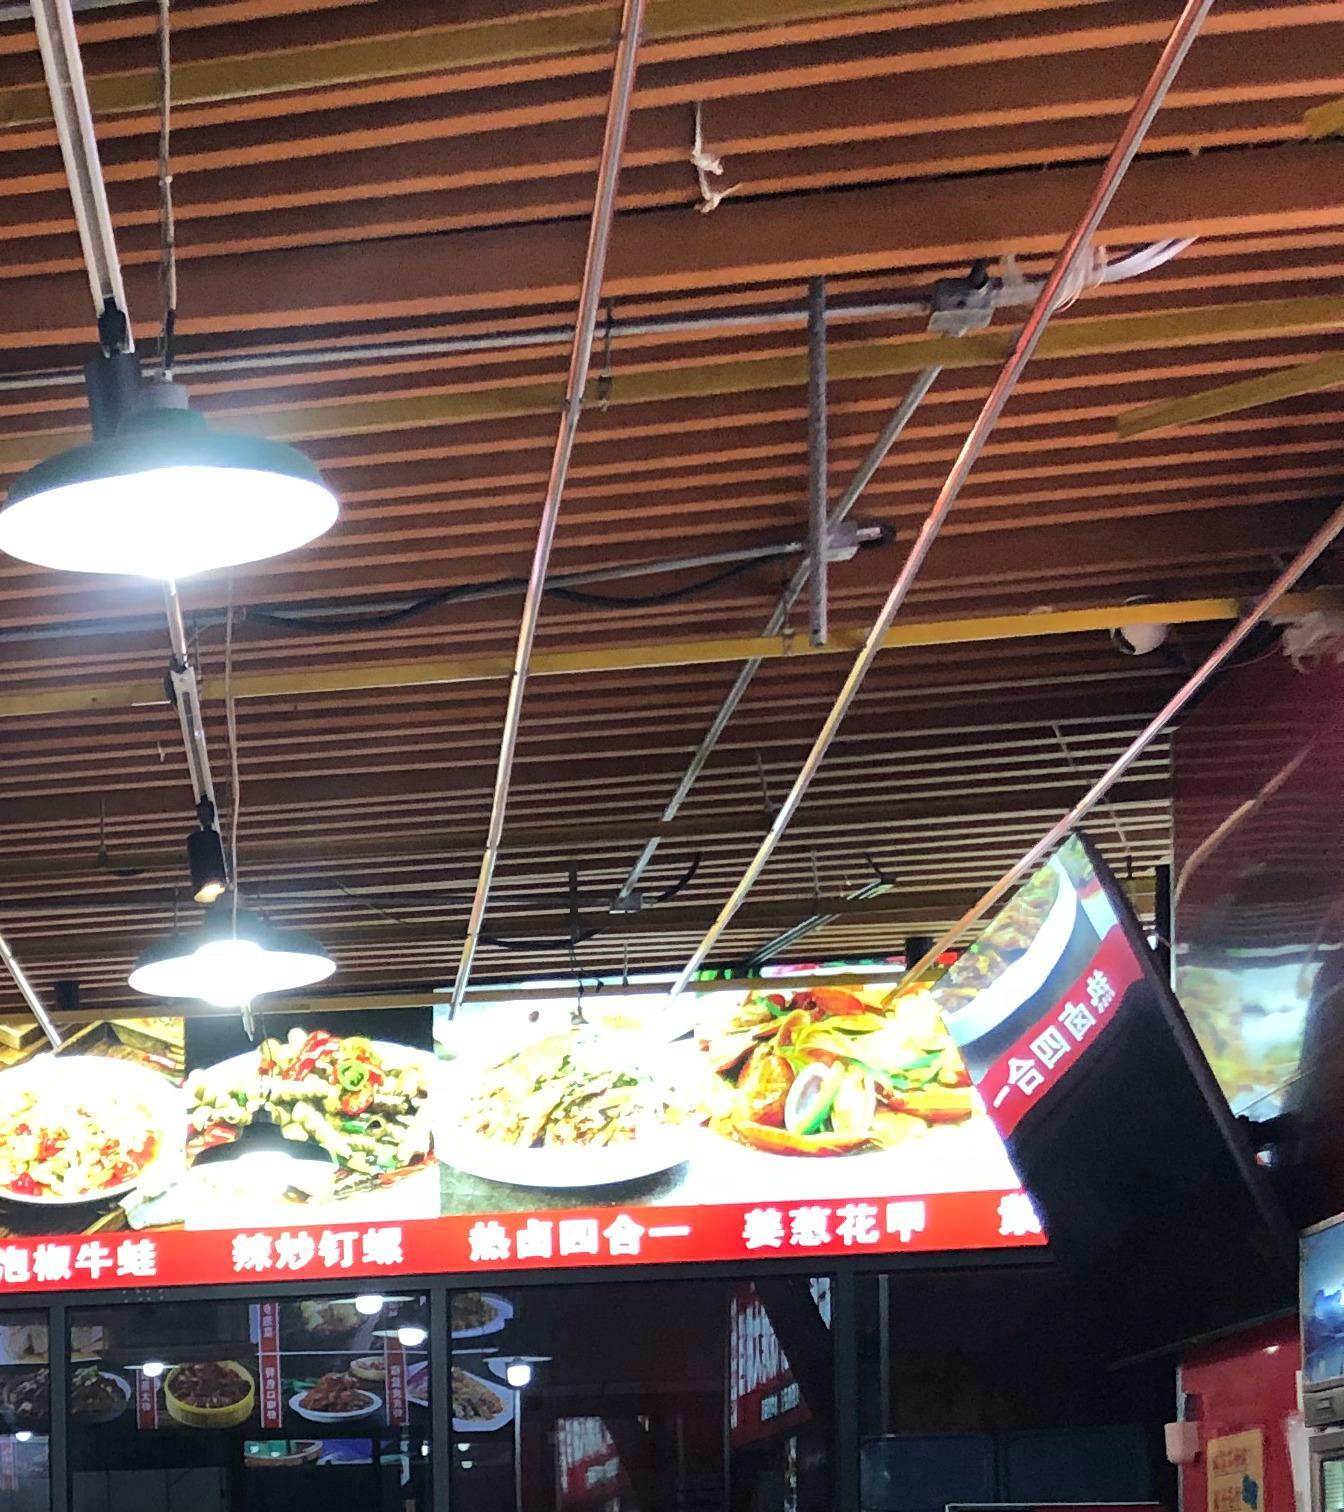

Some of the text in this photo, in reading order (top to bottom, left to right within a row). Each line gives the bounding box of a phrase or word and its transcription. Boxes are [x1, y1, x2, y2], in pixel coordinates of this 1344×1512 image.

[469, 1217, 692, 1263] 热卤四合一
[743, 1203, 926, 1248] 姜葱花甲
[233, 1228, 404, 1272] 辣炒钉螺
